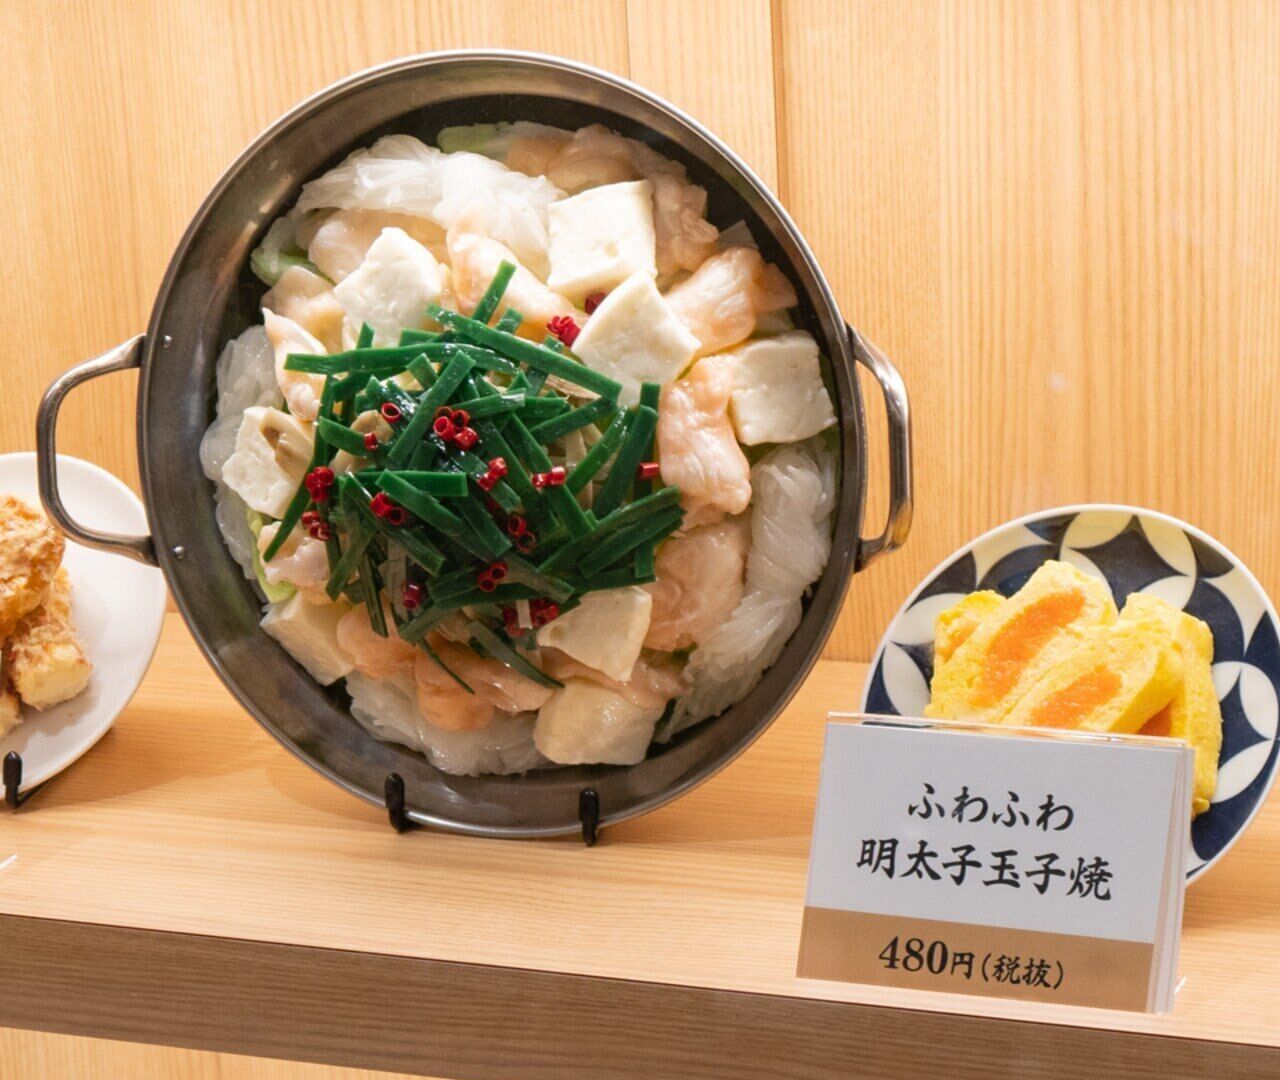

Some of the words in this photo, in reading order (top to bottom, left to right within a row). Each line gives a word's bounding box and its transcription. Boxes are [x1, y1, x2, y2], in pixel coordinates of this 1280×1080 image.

[907, 783, 1074, 832] ふわふわ
[856, 837, 1114, 901] 明太子玉子焼
[878, 935, 1063, 990] 480円（税抜）
